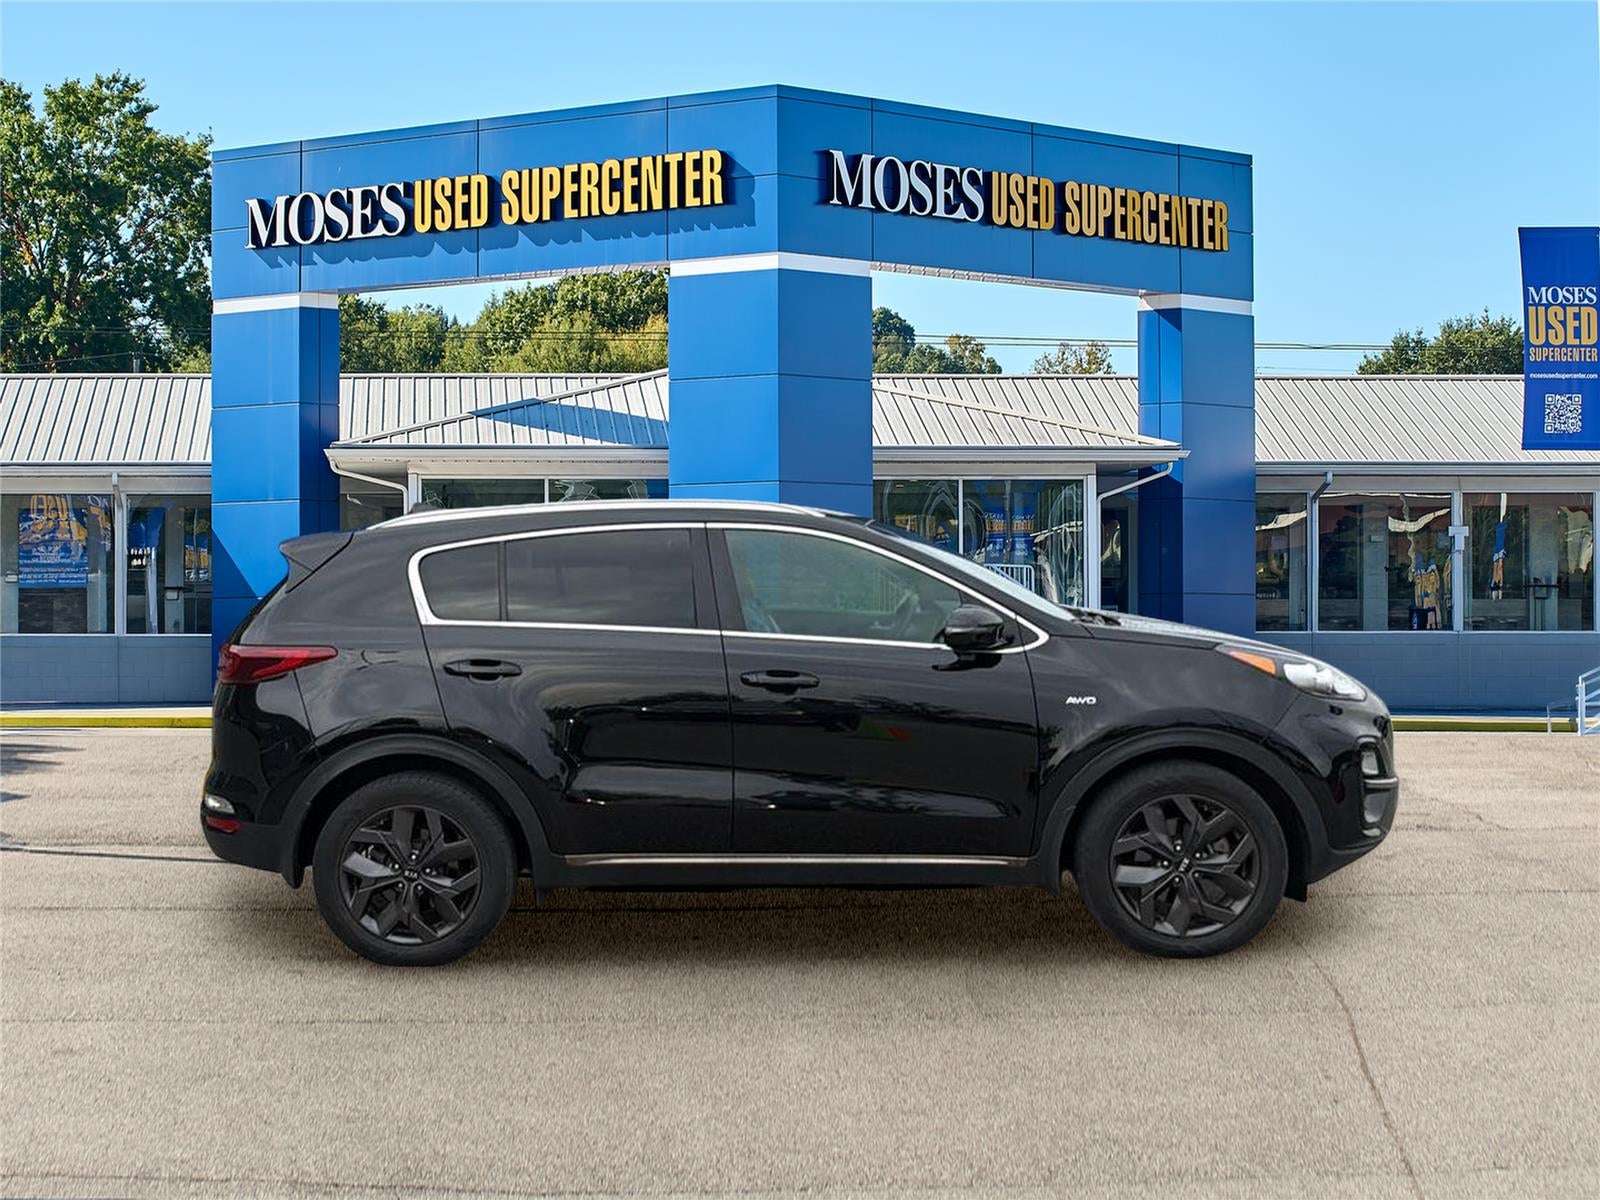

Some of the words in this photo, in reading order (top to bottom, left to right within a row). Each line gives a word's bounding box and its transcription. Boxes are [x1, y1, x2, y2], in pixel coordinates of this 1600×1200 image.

[245, 182, 409, 250] MOSES
[412, 173, 489, 233] USED
[500, 149, 724, 226] SUPERCENTER
[829, 149, 986, 223] MOSES
[990, 170, 1056, 231] USED
[1064, 180, 1231, 252] SUPERCENTER
[1527, 286, 1598, 304] MOSES
[1528, 306, 1598, 346] USED
[1529, 347, 1598, 362] SUPERCENTER
[1065, 696, 1097, 705] AWD
